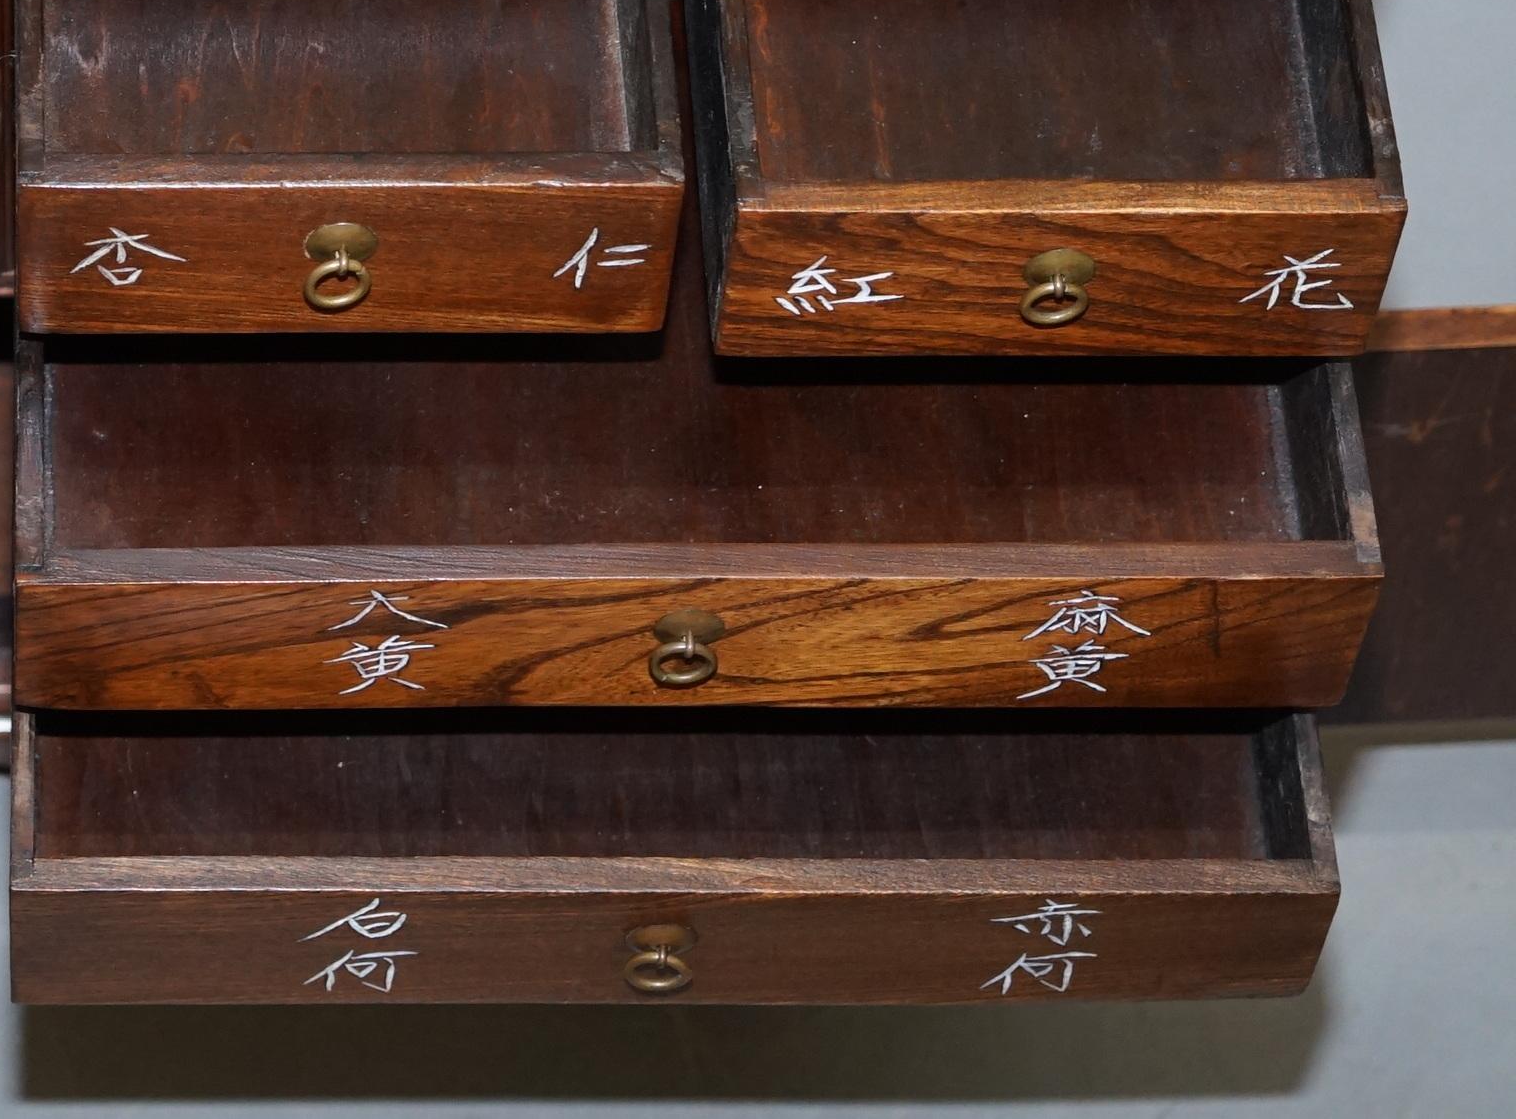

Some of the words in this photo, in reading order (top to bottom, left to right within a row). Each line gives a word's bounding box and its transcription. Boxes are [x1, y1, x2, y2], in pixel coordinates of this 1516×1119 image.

[69, 226, 189, 287] 杏
[552, 227, 651, 288] 仁
[775, 255, 905, 315] 紅
[1238, 248, 1355, 310] 花
